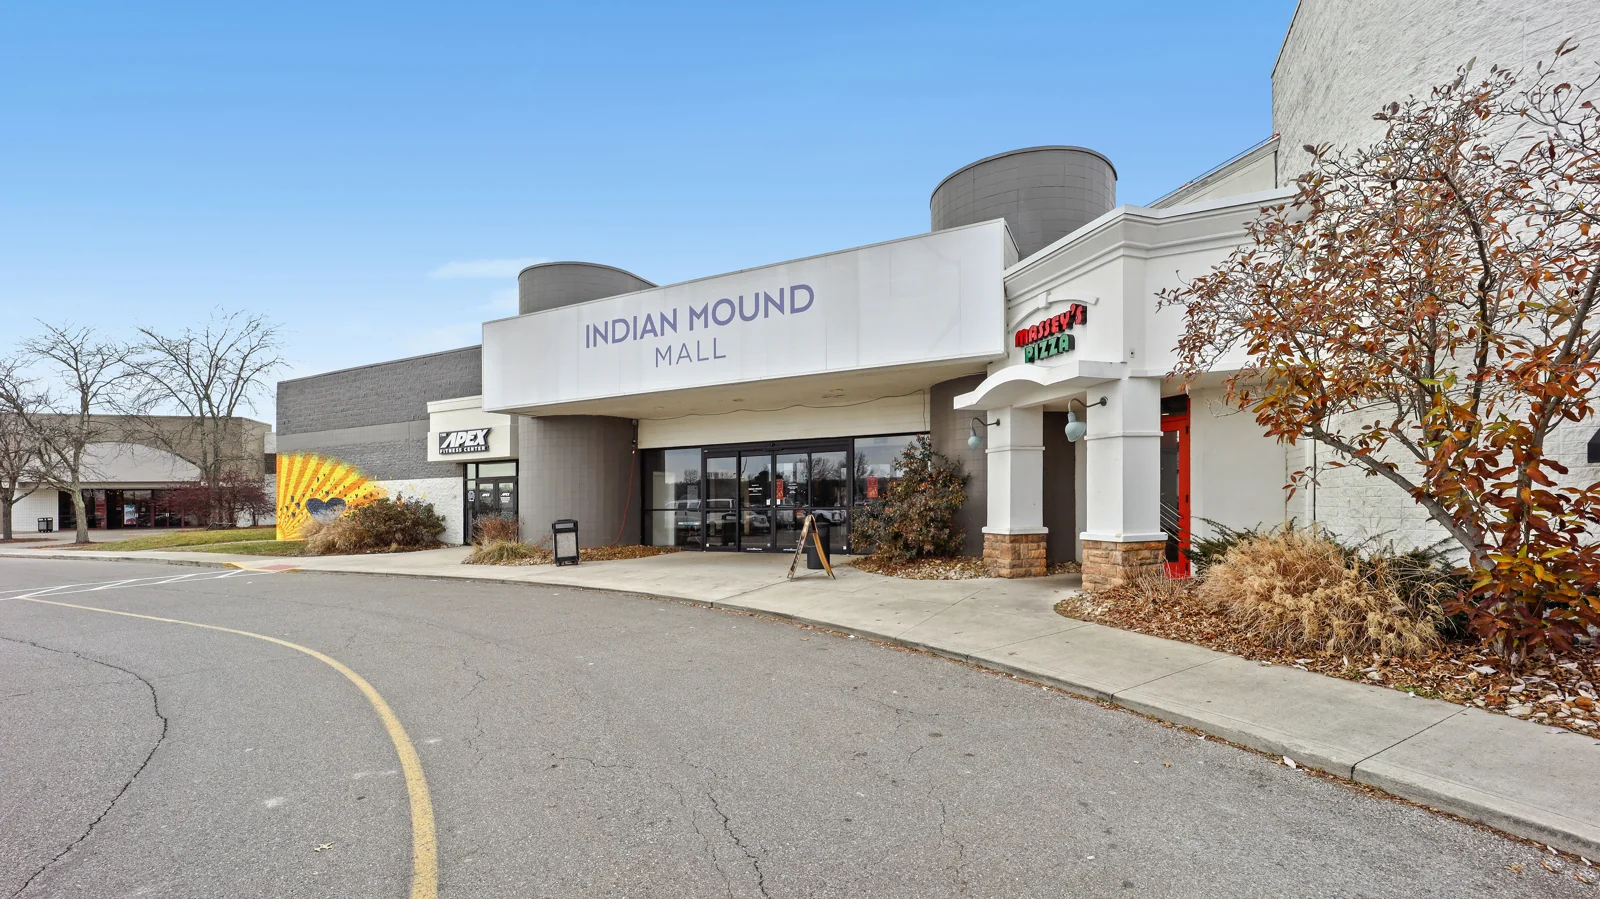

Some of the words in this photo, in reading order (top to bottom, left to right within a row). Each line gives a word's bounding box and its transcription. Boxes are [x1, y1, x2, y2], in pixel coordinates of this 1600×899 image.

[586, 308, 677, 348] INDIAN
[689, 284, 815, 331] MOUND
[1015, 303, 1085, 347] MASSEY'S
[656, 337, 726, 368] MALL
[1025, 333, 1071, 363] PIZZA
[440, 428, 488, 448] APEX
